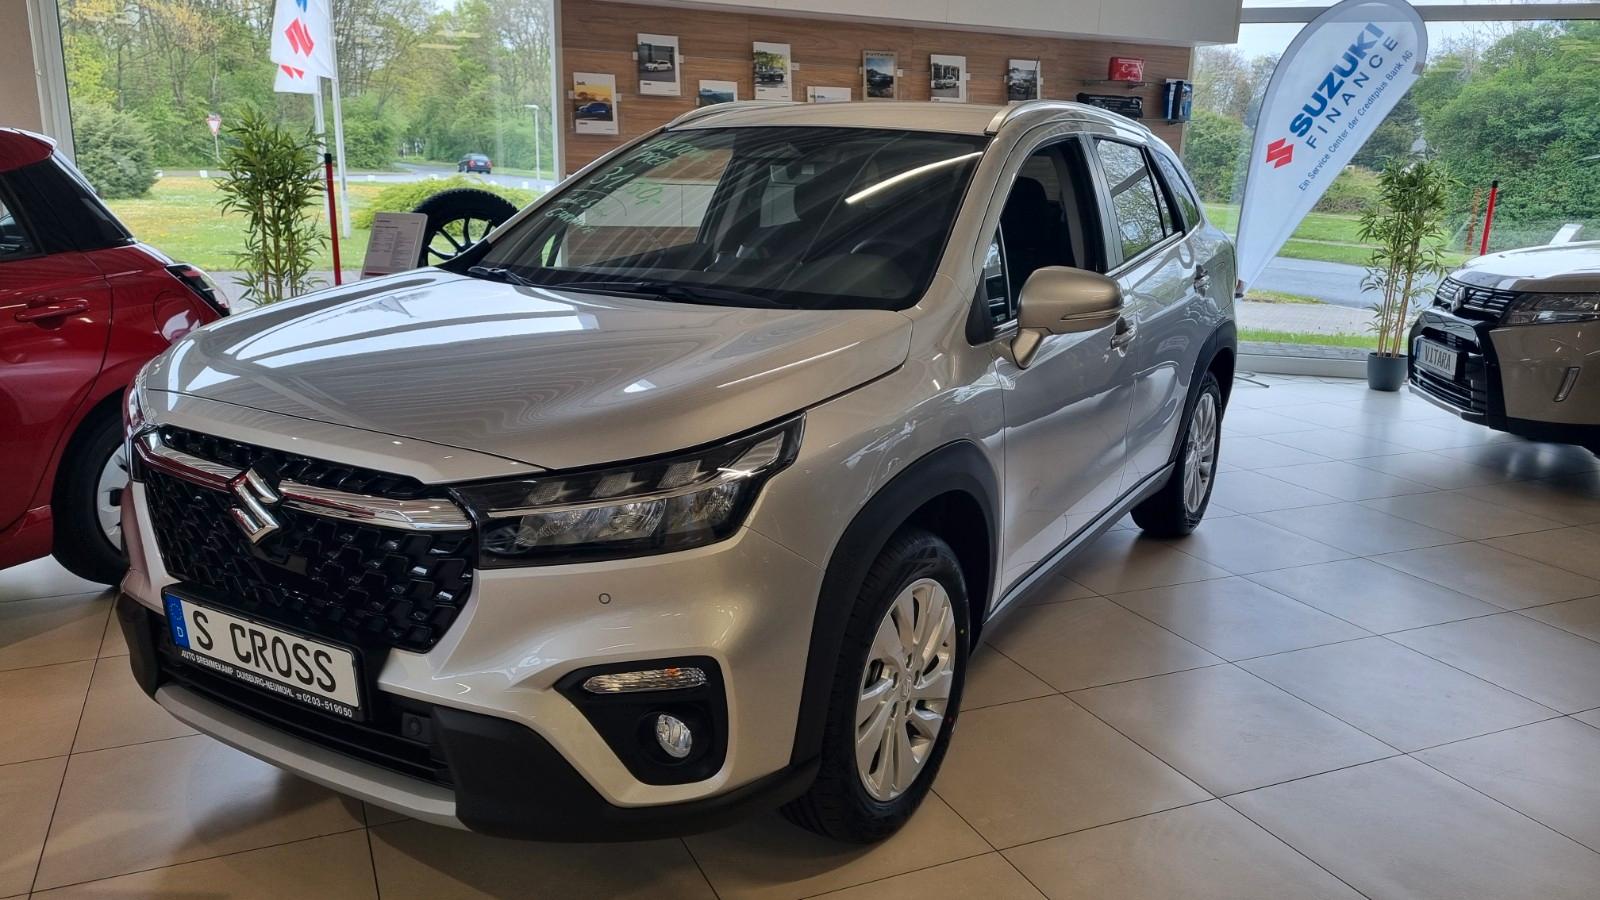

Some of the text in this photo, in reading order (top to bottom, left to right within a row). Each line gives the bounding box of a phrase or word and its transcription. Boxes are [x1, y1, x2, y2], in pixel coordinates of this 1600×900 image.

[1290, 23, 1384, 138] SUZUKI
[1299, 50, 1413, 191] Ein Service Center der Creditplus Bank AG
[1306, 36, 1399, 149] FINANCE
[1424, 345, 1451, 370] VITARA
[176, 626, 184, 638] D
[181, 650, 196, 662] AUTO
[193, 610, 336, 692] S CROSS
